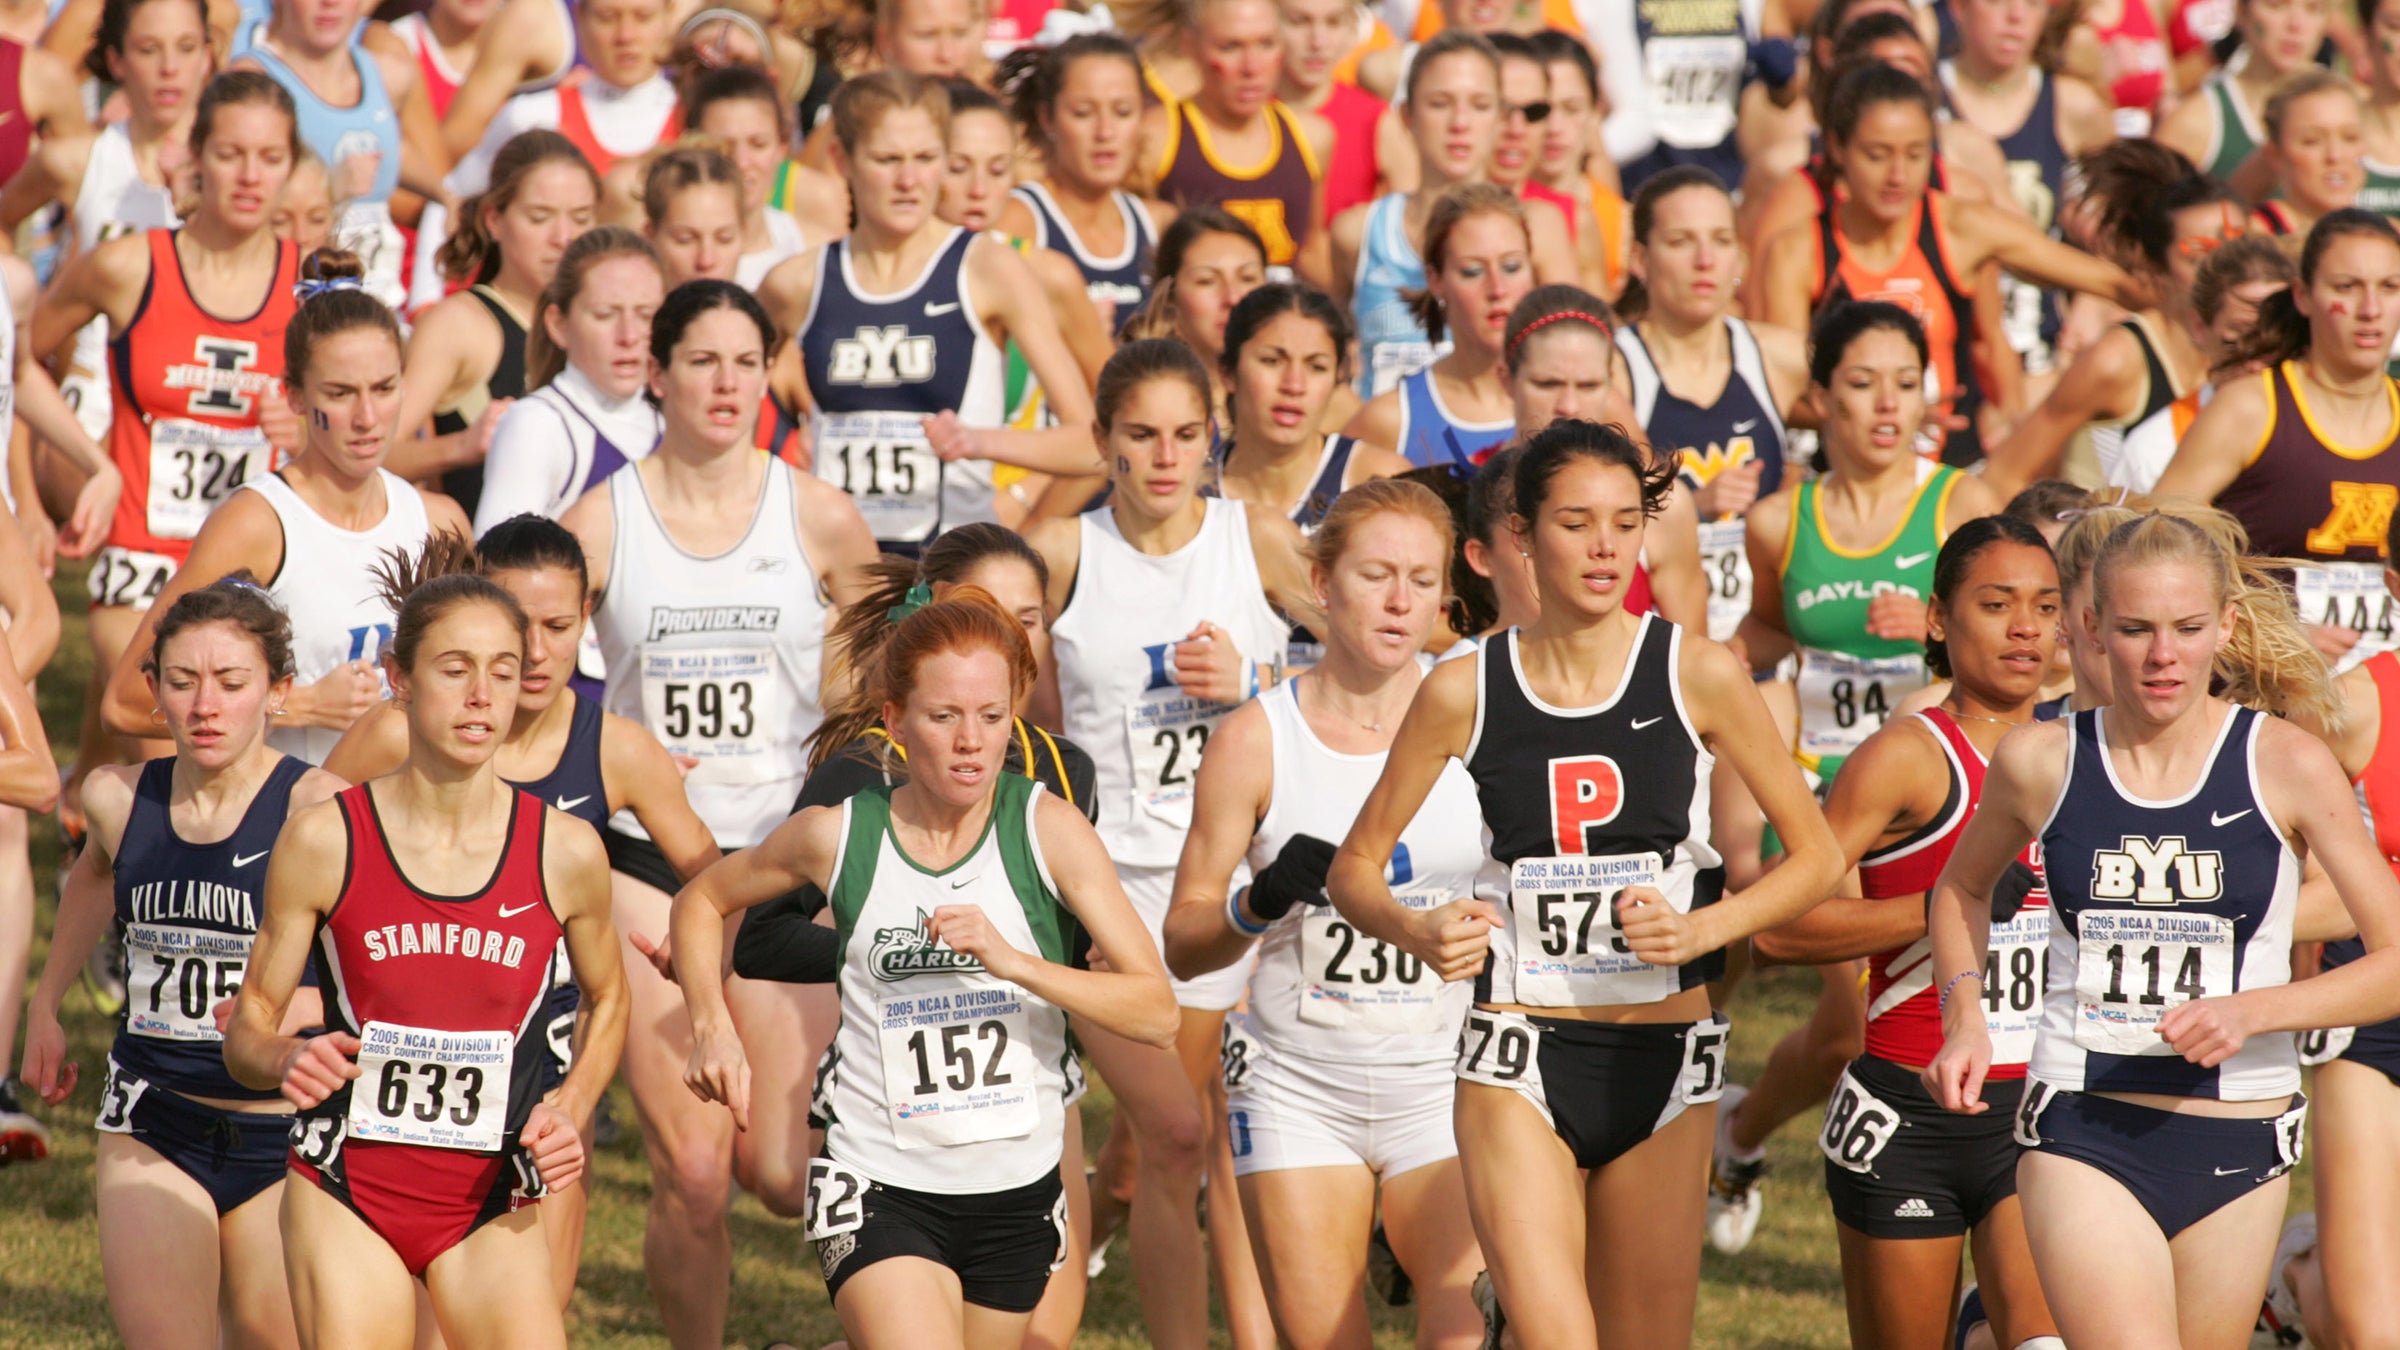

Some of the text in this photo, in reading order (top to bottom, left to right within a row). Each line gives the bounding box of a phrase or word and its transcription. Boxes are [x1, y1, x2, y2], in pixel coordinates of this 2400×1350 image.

[828, 324, 936, 388] BYU
[173, 449, 249, 500] 324
[840, 445, 915, 494] 115
[647, 606, 780, 642] PROVIDENCE
[664, 682, 754, 738] 593
[1832, 679, 1890, 728] 84
[1548, 755, 1624, 857] P
[1515, 873, 1655, 889] CROSS COUNTRY CHAMPIONSHIPS
[1521, 864, 1547, 877] 2005
[1552, 864, 1585, 876] NCAA
[1590, 861, 1640, 876] DIVISION
[2090, 835, 2224, 906] BYU
[131, 880, 258, 932] VILLANOVA
[2082, 930, 2224, 944] CROSS COUNTRY CHAMPIONSHIPS
[2087, 916, 2115, 929] 2005
[2120, 916, 2152, 930] NCAA
[2158, 918, 2210, 933] DIVISION
[133, 927, 158, 942] 2005
[162, 932, 191, 946] NCAA
[196, 936, 244, 951] DIVISION
[133, 940, 154, 952] CROSS
[157, 944, 190, 955] COUNTRY
[364, 923, 526, 969] STANFORD
[2103, 944, 2206, 1005] 114
[887, 1001, 914, 1017] 2005
[918, 996, 950, 1013] NCAA
[956, 990, 1006, 1008] DIVISION
[2101, 1010, 2127, 1020] NCAA
[147, 1020, 171, 1031] NCAA
[882, 1003, 1021, 1030] CROSS COUNTRY CHAMPIONSHIPS
[174, 1029, 198, 1038] Indiana
[371, 1028, 399, 1045] 2005
[404, 1034, 436, 1049] NCAA
[442, 1038, 491, 1051] DIVISION
[363, 1043, 504, 1063] CROSS COUNTRY CHAMPIONSHIPS
[908, 1020, 1012, 1095] 152
[377, 1059, 483, 1126] 633
[972, 1101, 990, 1109] State
[992, 1096, 1024, 1108] University
[913, 1103, 939, 1113] NCAA
[1824, 1078, 1889, 1163] 86
[374, 1125, 399, 1135] NCAA
[403, 1133, 429, 1142] Indiana
[431, 1136, 450, 1145] State
[453, 1138, 488, 1149] University
[429, 1127, 464, 1138] Hosted by
[808, 1165, 859, 1232] 52
[1894, 1208, 1935, 1217] adidas
